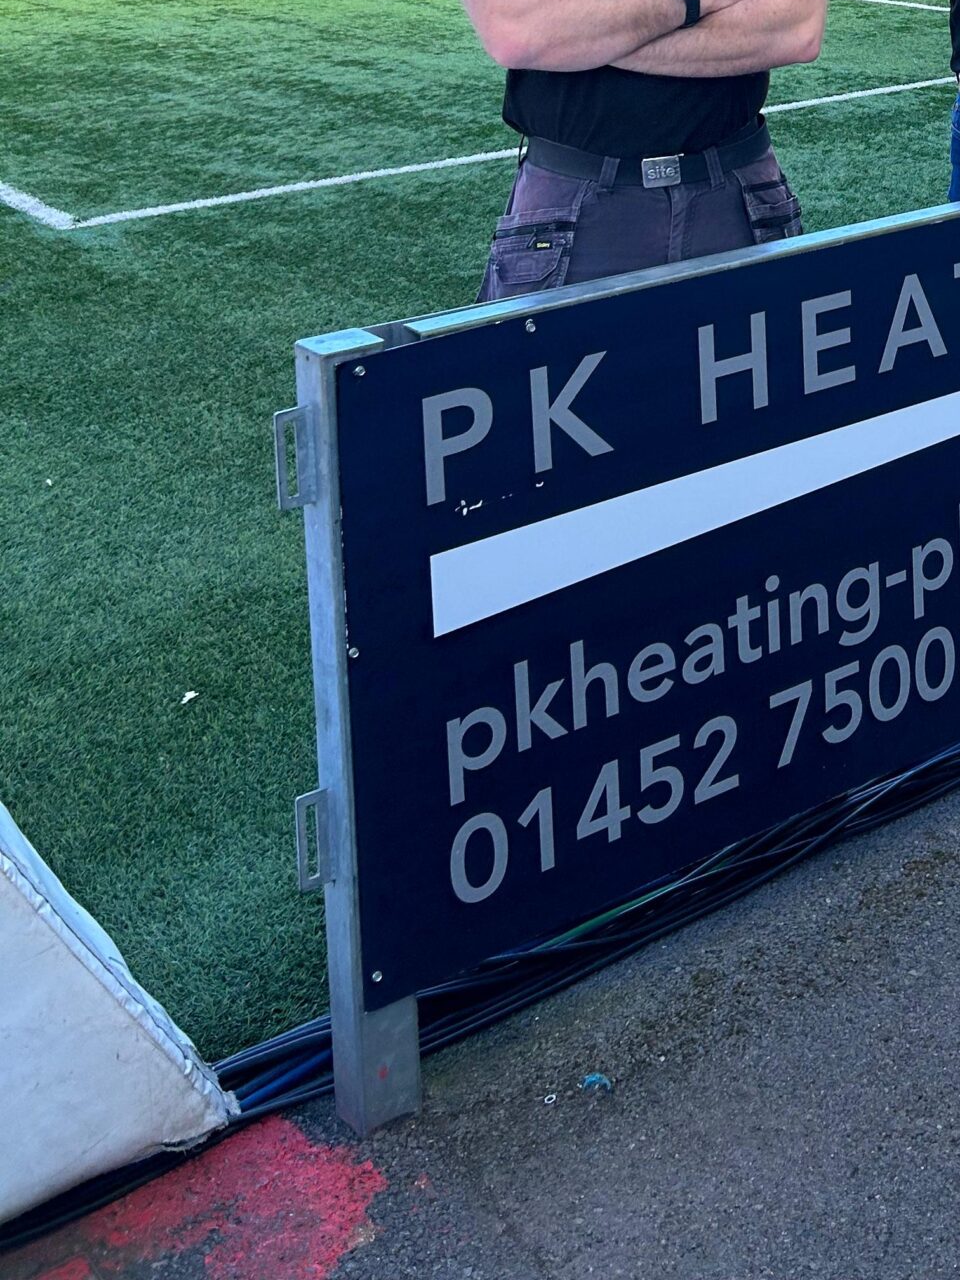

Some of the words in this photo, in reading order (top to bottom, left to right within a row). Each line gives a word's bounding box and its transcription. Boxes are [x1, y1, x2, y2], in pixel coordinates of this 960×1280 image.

[647, 165, 676, 180] site
[422, 350, 615, 506] PK
[450, 715, 740, 905] 01452
